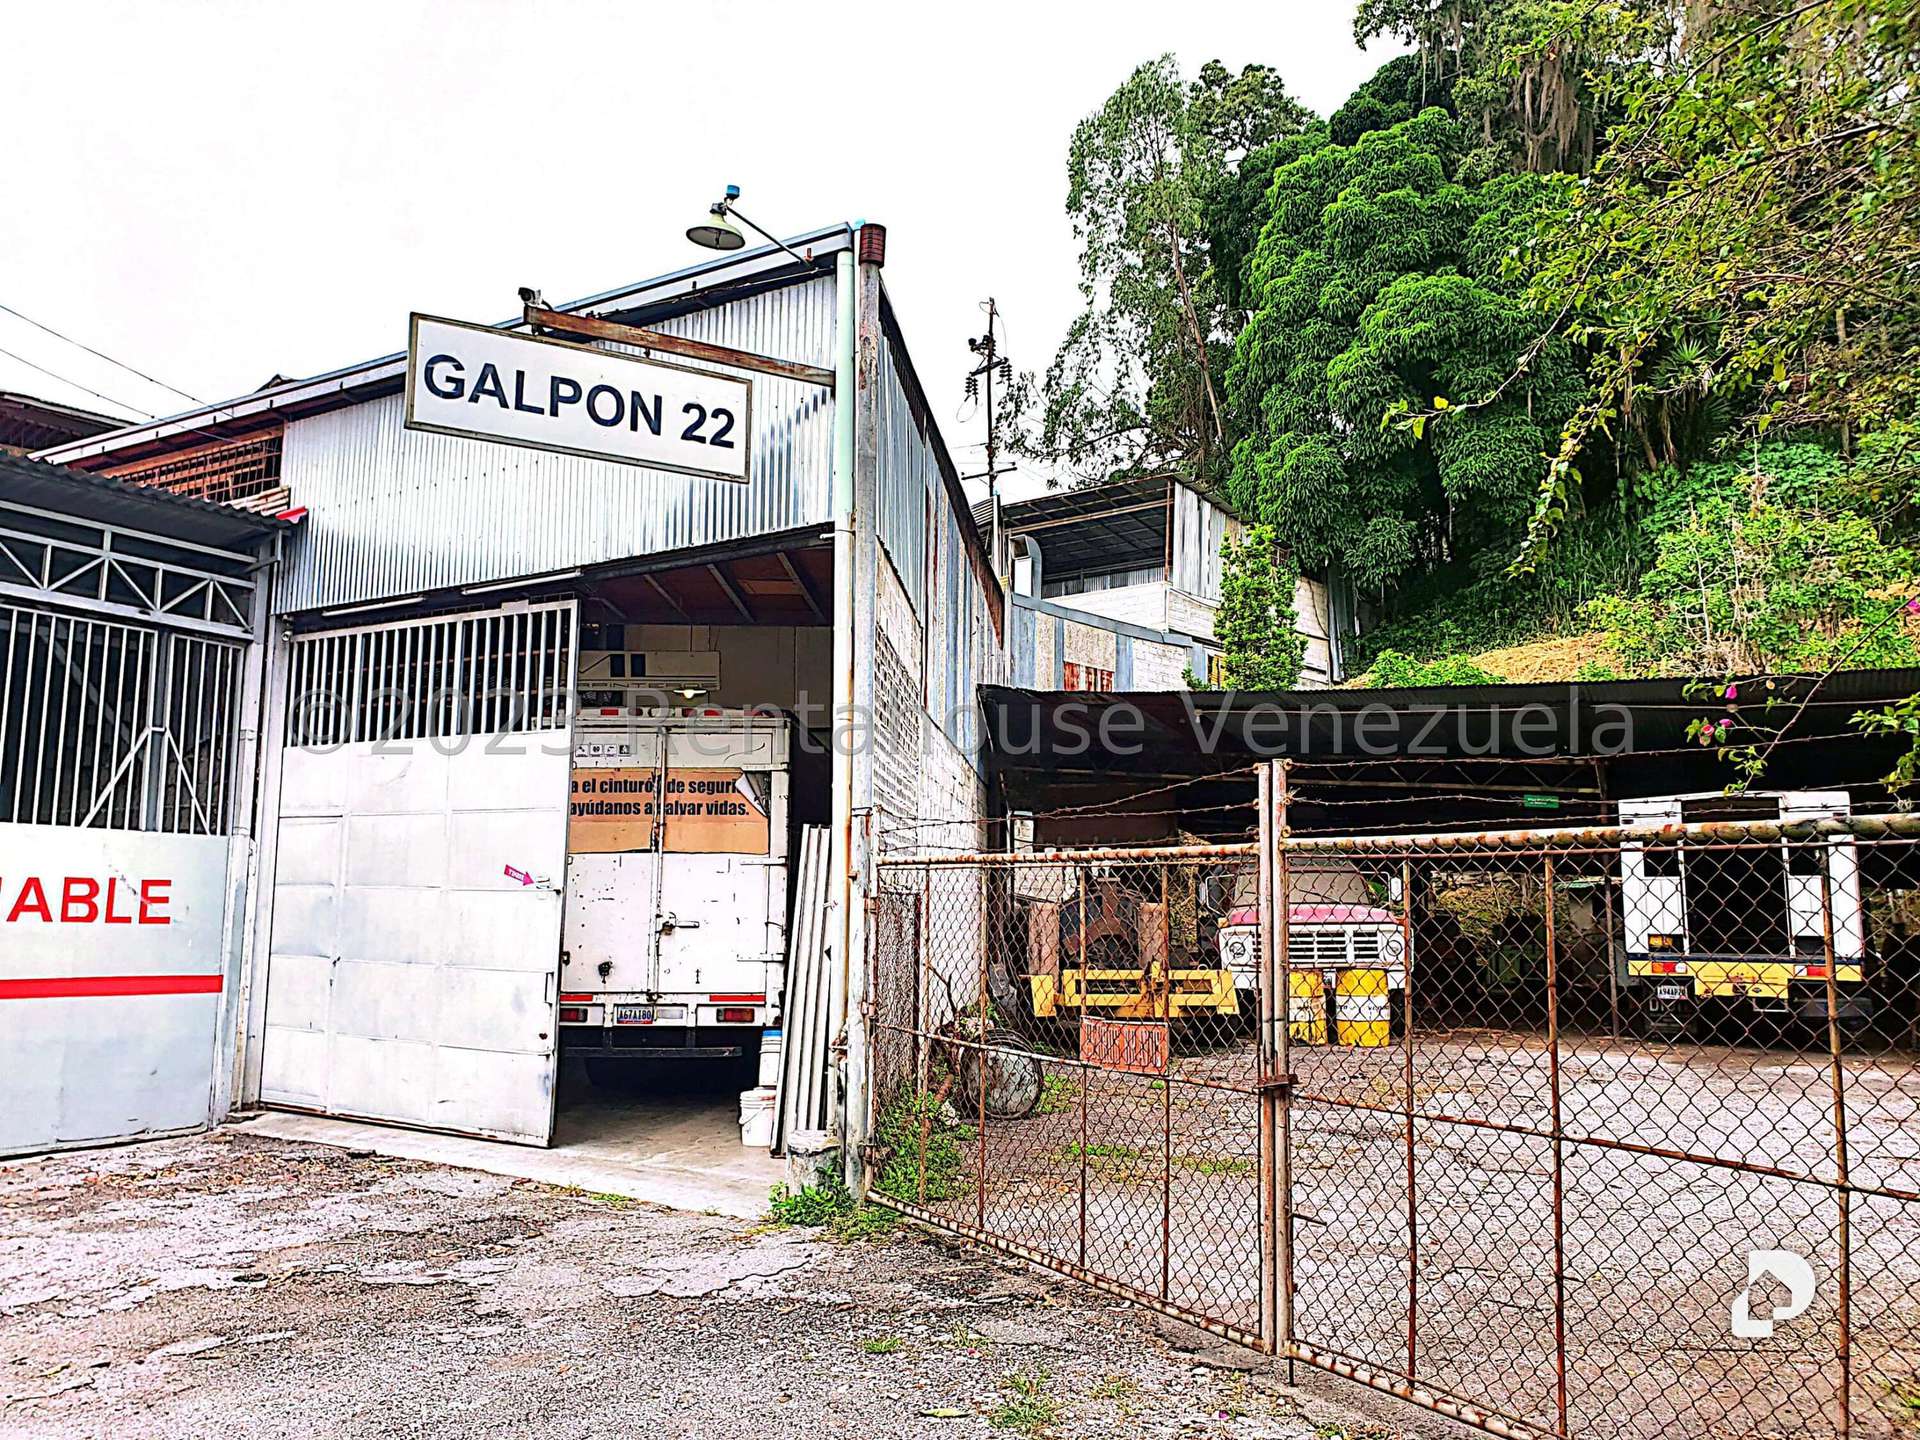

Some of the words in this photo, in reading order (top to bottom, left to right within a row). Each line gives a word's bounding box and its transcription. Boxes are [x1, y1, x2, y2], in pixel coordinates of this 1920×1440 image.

[424, 354, 663, 436] GALPON
[680, 402, 735, 449] 22
[582, 778, 596, 794] el
[667, 778, 685, 794] de
[570, 799, 641, 817] ayúdanos
[644, 802, 653, 815] a
[655, 800, 703, 816] alvar
[706, 800, 750, 816] vidas.
[0, 876, 172, 924] ABLE
